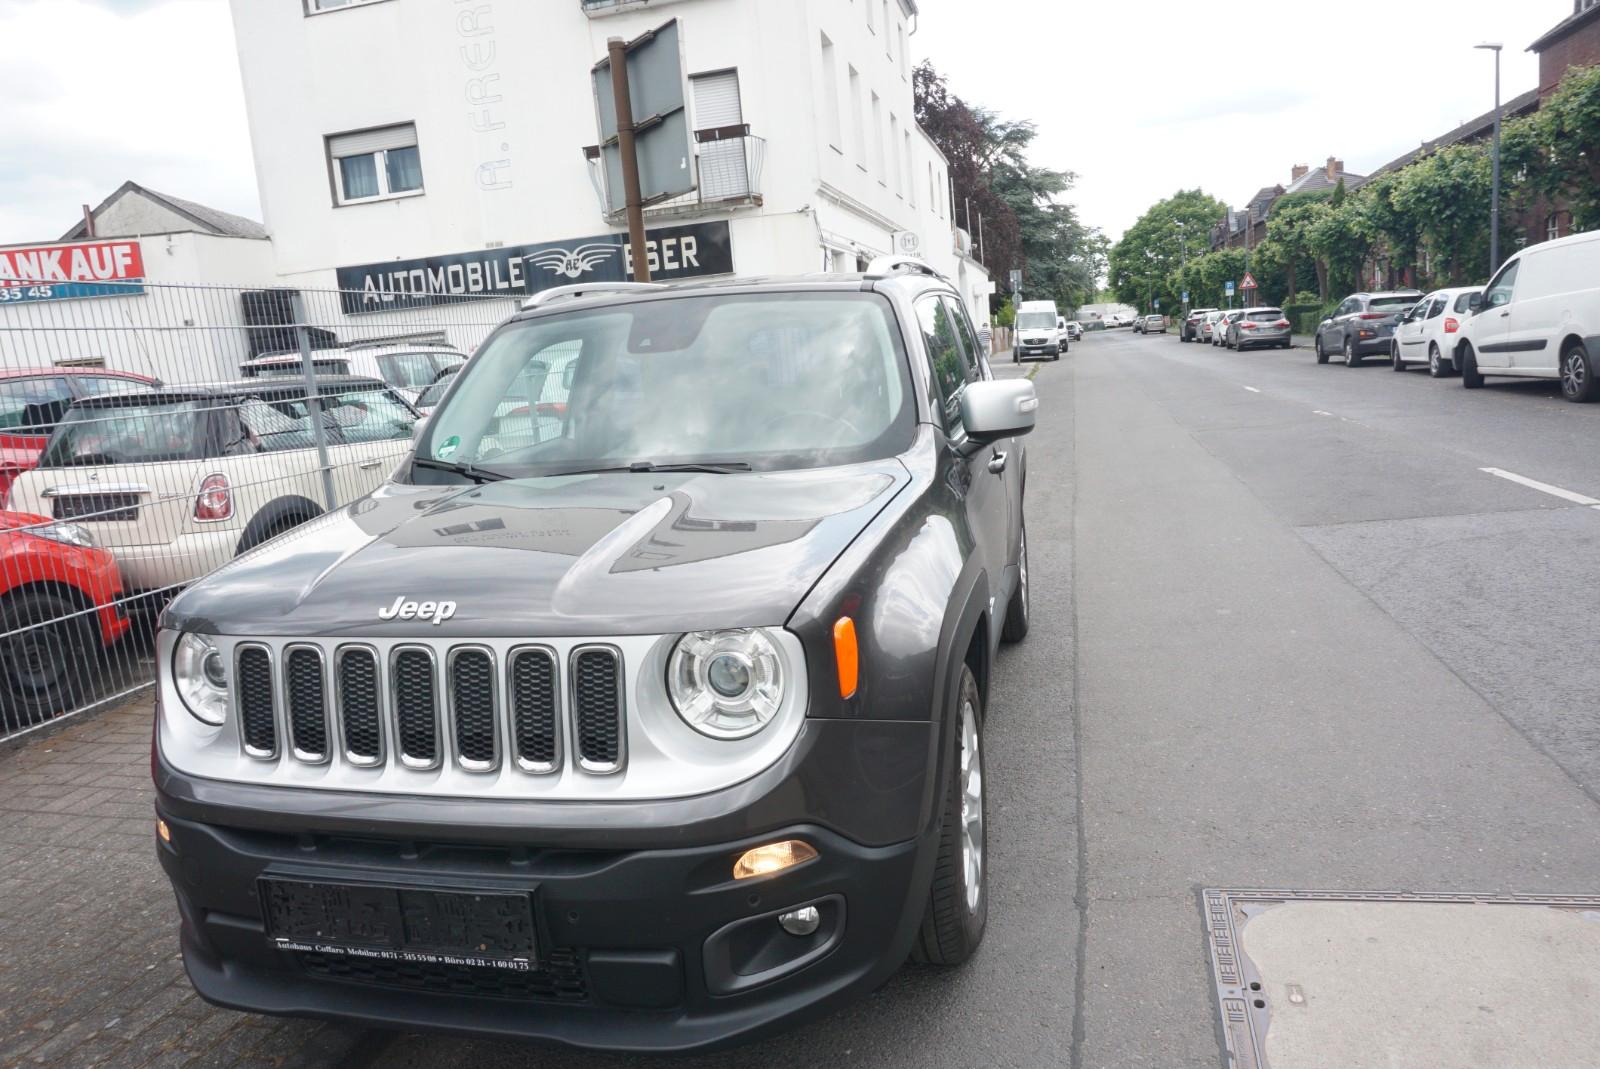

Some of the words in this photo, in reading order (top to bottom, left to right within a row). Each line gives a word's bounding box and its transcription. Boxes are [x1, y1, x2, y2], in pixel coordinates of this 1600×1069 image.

[0, 244, 132, 285] ANKAUF
[28, 285, 52, 298] 45
[362, 257, 526, 304] AUTOMOBILE
[379, 596, 456, 624] Jeep
[277, 942, 312, 952] Autohaus
[444, 956, 465, 965] Büro
